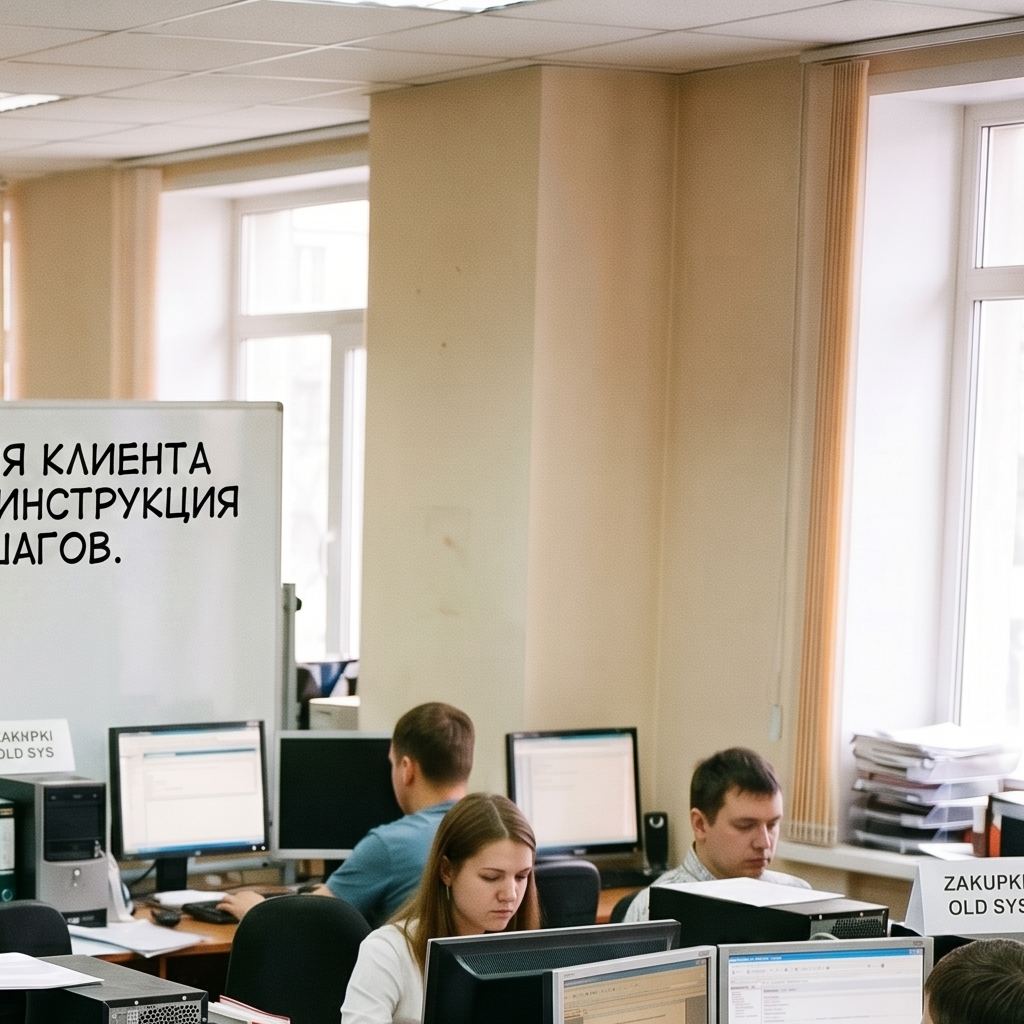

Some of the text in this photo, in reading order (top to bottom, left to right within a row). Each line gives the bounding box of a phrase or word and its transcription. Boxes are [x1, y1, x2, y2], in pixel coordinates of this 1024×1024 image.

[42, 441, 212, 477] КЛИЕНТА
[27, 746, 55, 759] SYS
[948, 899, 988, 916] OLD
